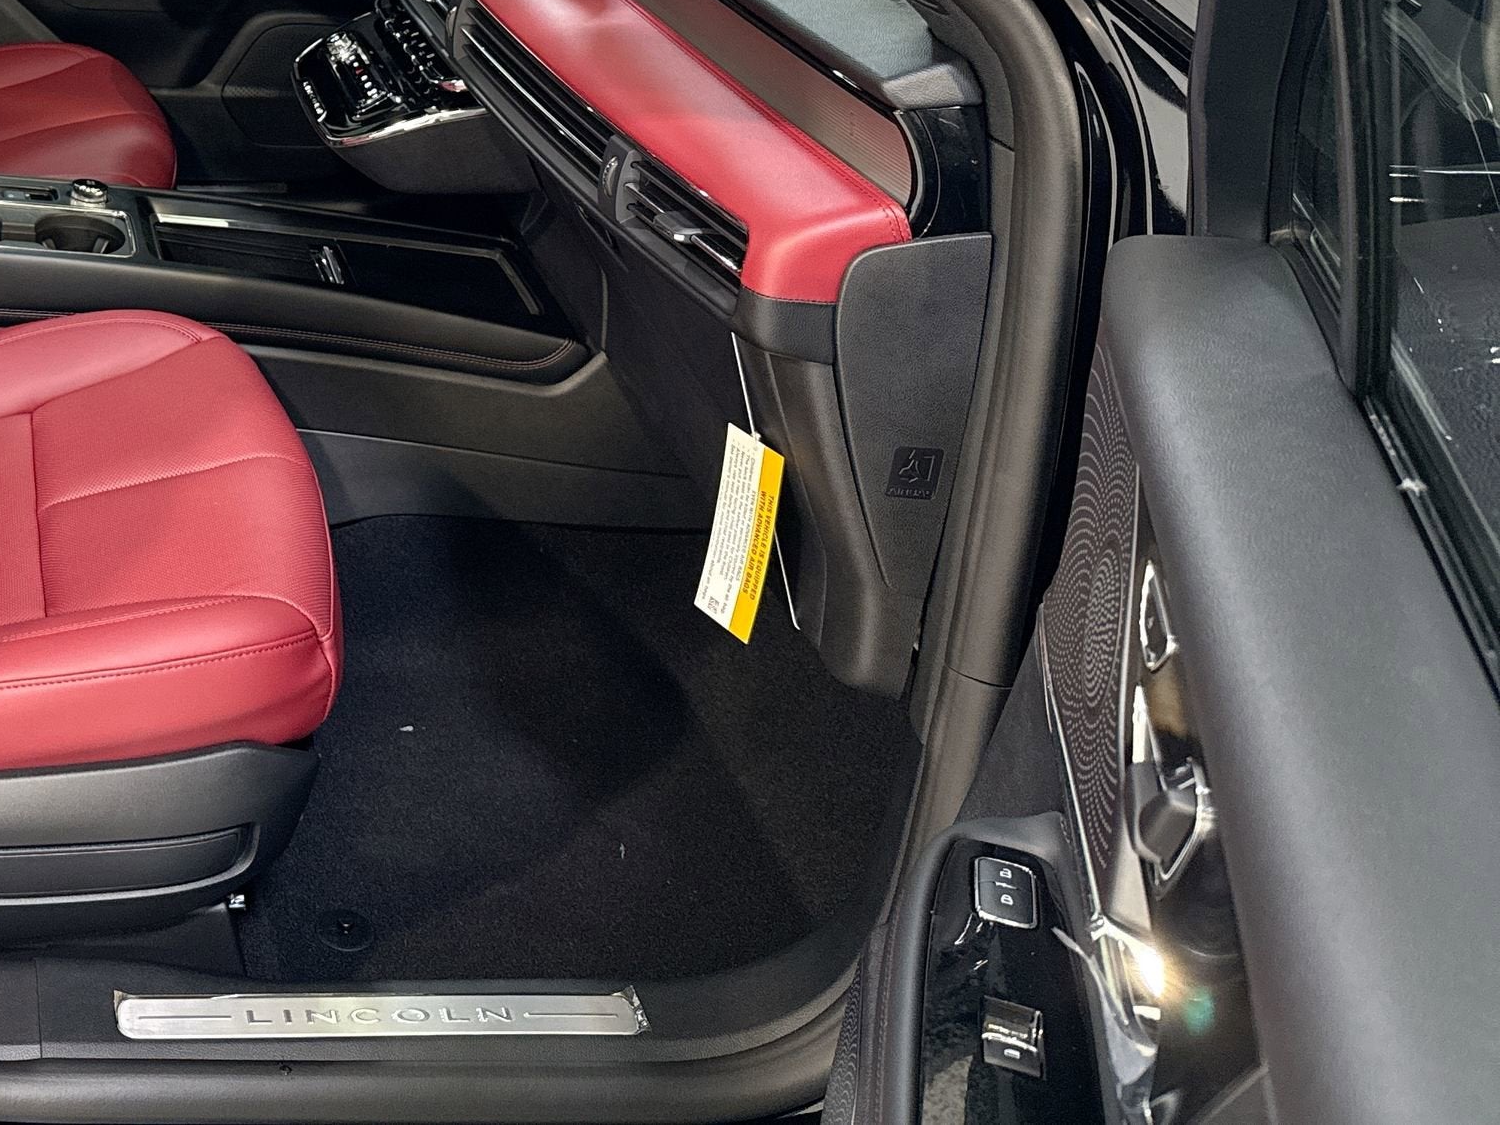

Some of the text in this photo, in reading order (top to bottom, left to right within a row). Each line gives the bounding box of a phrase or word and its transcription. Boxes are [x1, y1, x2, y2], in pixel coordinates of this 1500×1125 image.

[742, 489, 767, 595] WITH ADVANCED AIR BAGS
[749, 493, 774, 602] THIS VEHICLE IS EQUIPPED
[244, 1006, 514, 1026] LINCOLN
